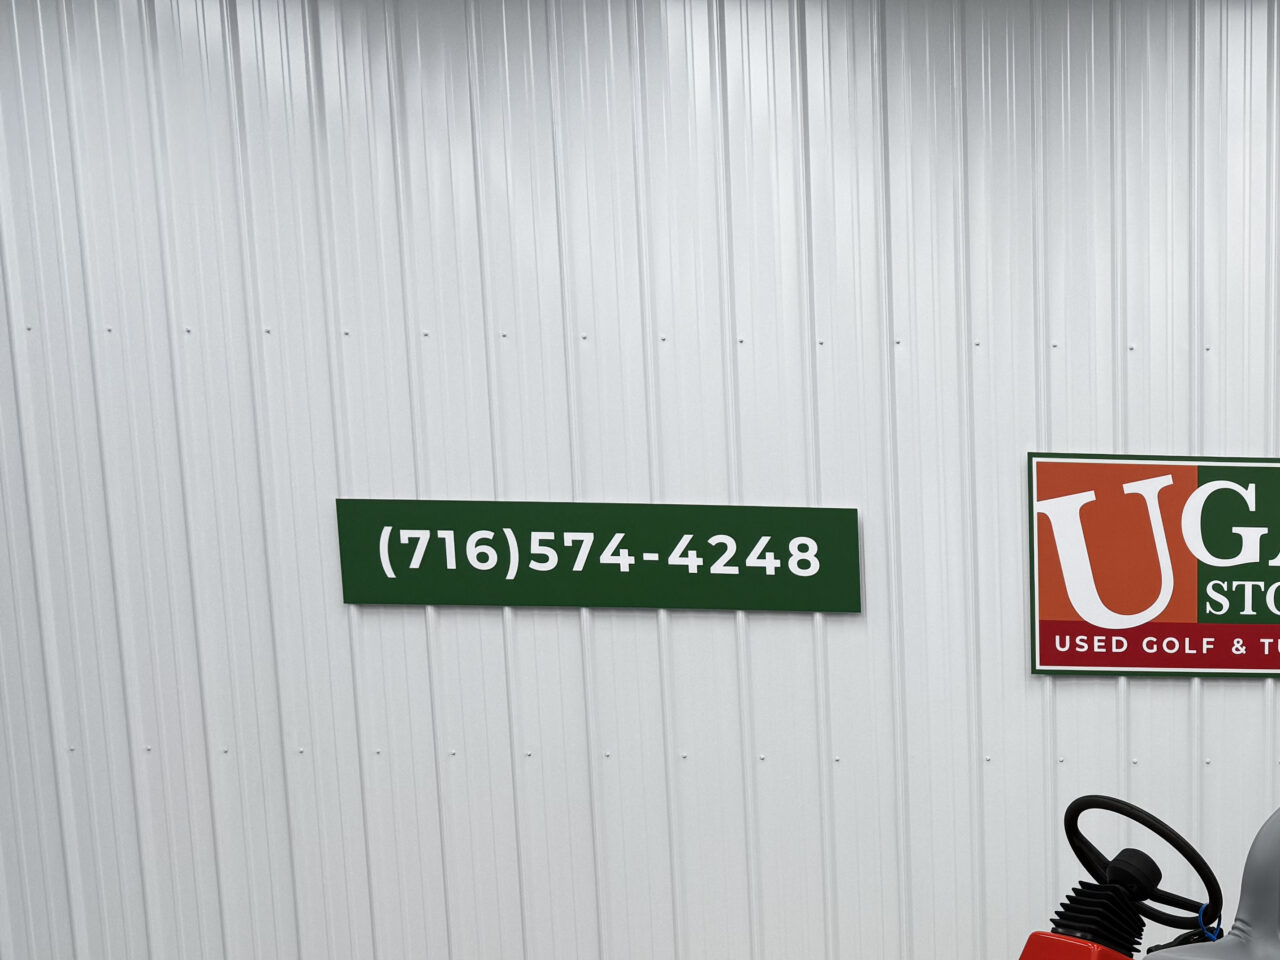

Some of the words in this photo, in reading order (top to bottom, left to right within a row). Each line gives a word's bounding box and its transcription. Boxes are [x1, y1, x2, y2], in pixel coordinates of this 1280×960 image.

[379, 526, 821, 580] (716)574-4248
[1054, 634, 1129, 654] USED
[1142, 635, 1216, 655] GOLF
[1231, 637, 1247, 656] &
